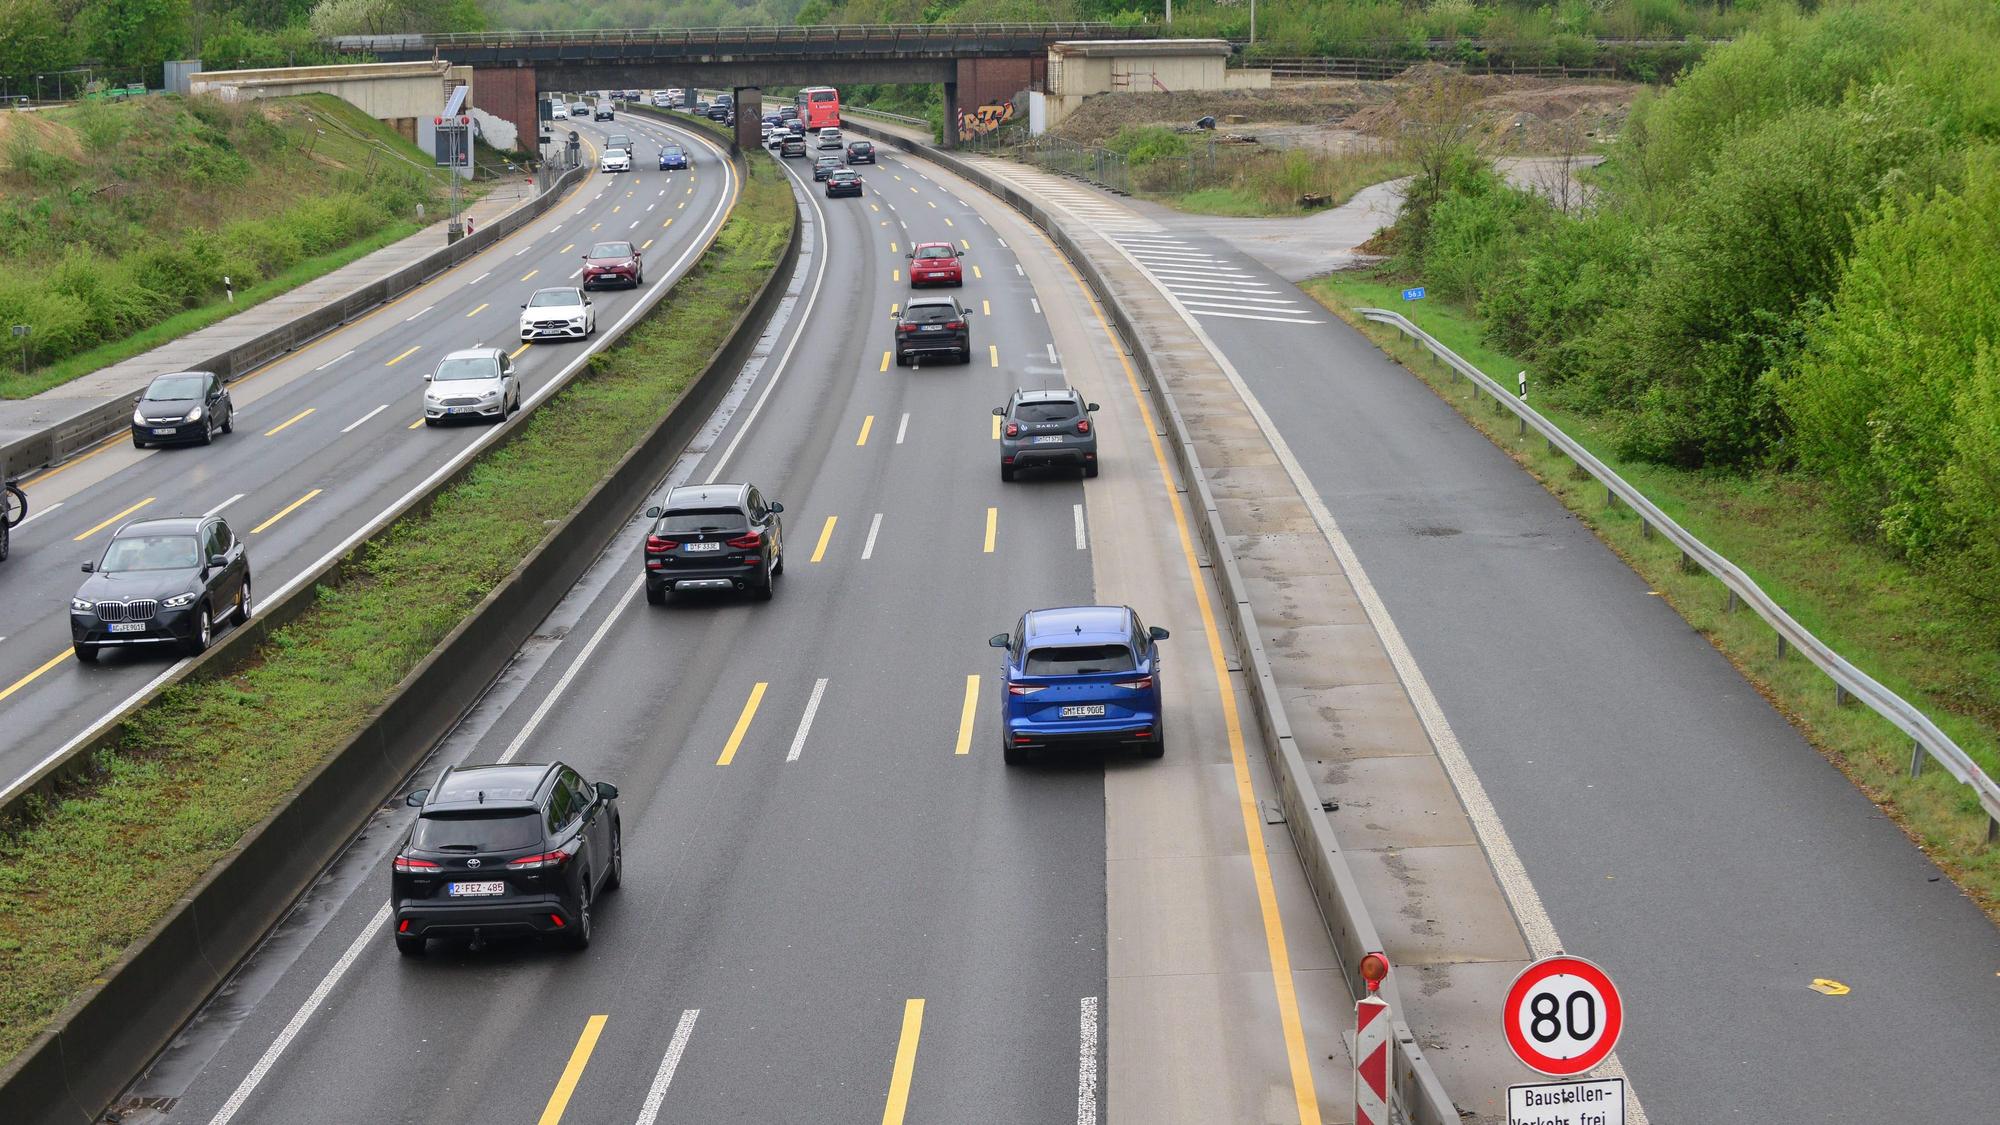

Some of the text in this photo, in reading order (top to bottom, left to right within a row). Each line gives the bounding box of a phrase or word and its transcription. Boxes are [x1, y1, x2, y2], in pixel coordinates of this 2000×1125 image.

[1531, 990, 1595, 1043] 80
[1526, 1086, 1612, 1106] Baustellen-
[1580, 1111, 1605, 1125] frei
